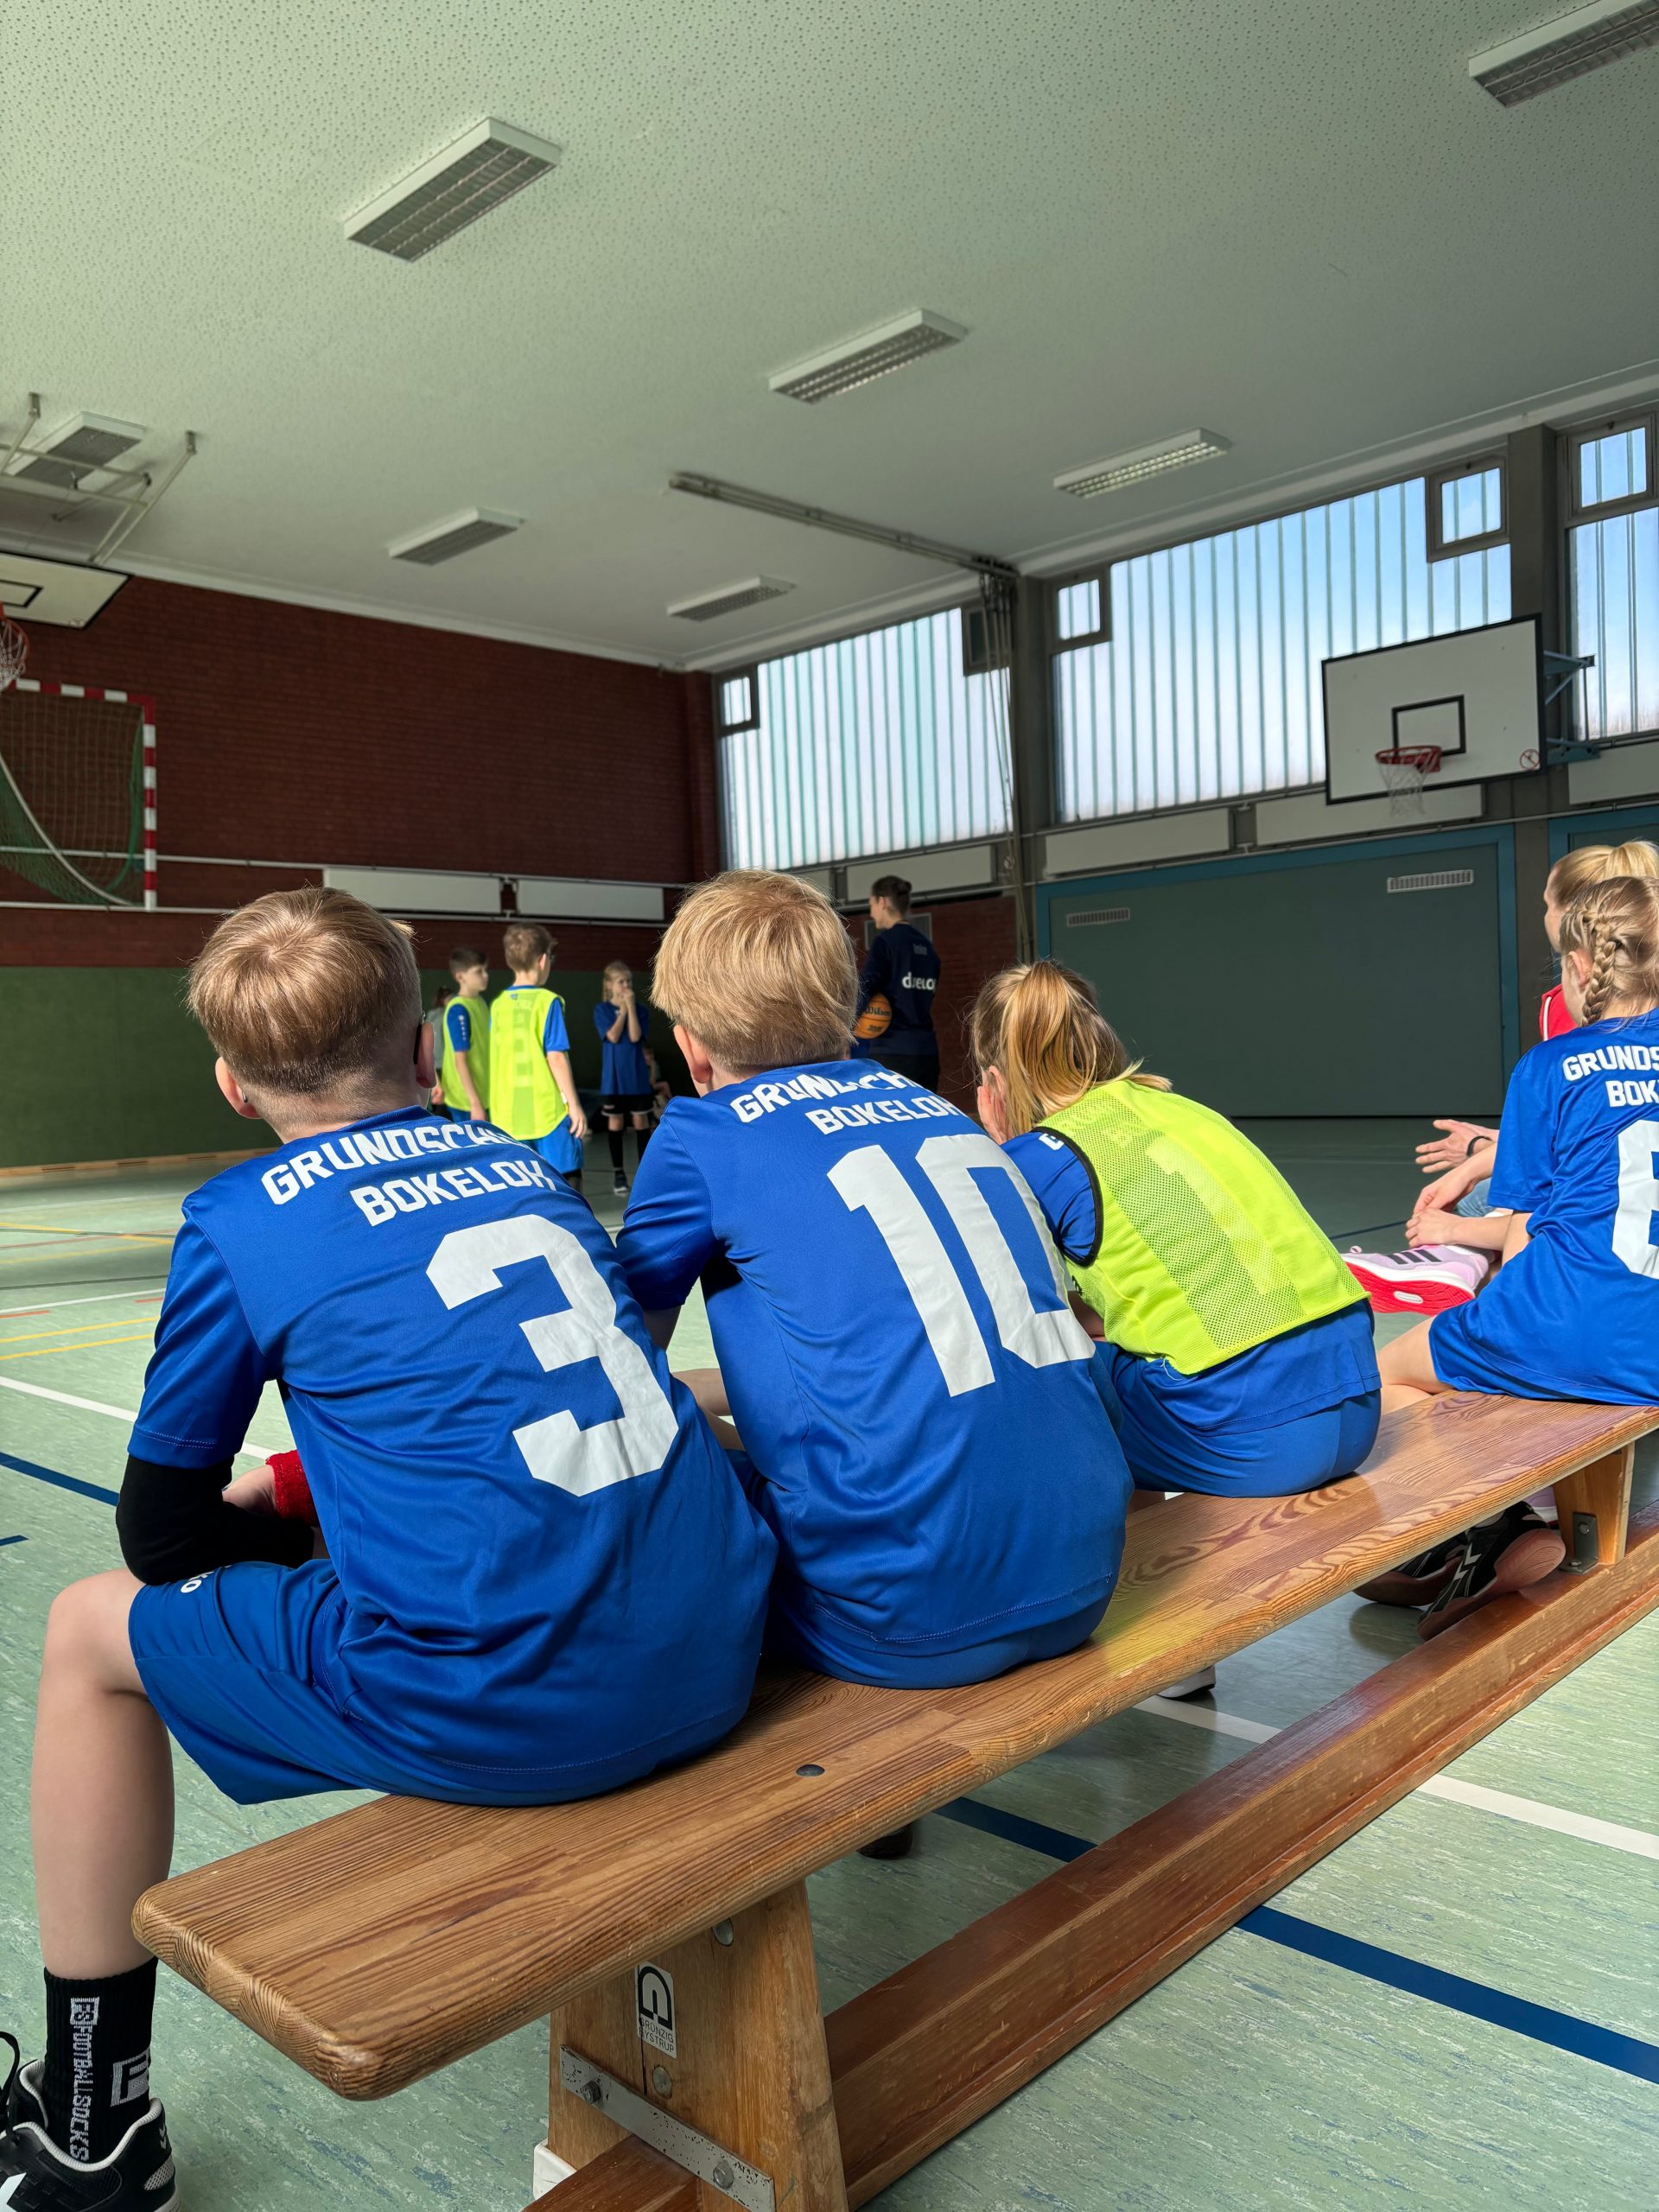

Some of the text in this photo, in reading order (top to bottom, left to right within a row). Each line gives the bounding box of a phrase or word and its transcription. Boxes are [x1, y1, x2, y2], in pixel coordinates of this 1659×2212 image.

[804, 1095, 963, 1135] BOKELOH
[1605, 1079, 1659, 1107] BOK
[350, 1160, 557, 1227] BOKELOH
[826, 1134, 1096, 1397] 10
[426, 1213, 679, 1497] 3
